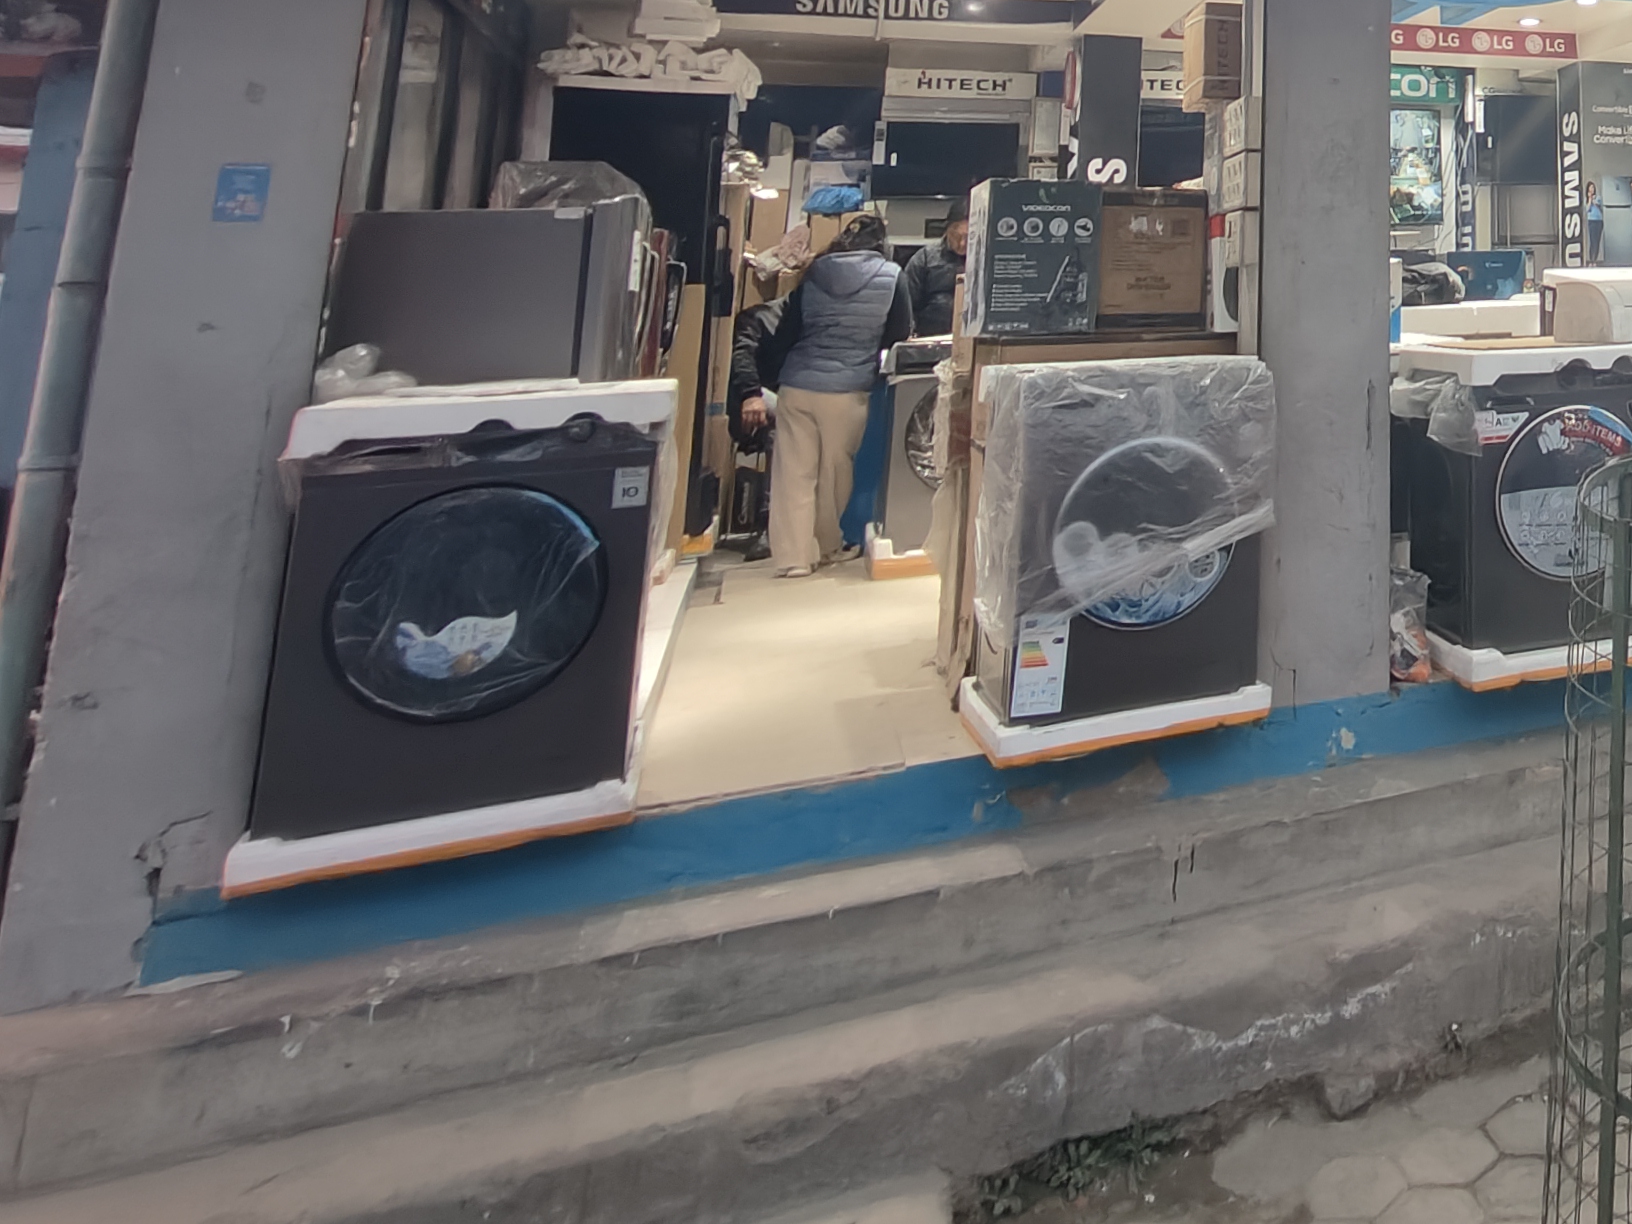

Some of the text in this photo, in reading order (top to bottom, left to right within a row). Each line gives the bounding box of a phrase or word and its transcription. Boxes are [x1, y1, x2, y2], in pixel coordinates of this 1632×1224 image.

[1438, 32, 1460, 47] LG
[1493, 35, 1514, 50] LG
[1545, 38, 1565, 53] LG
[916, 77, 1007, 92] HITECH
[1597, 125, 1622, 135] Make
[1590, 425, 1622, 447] ITEMS
